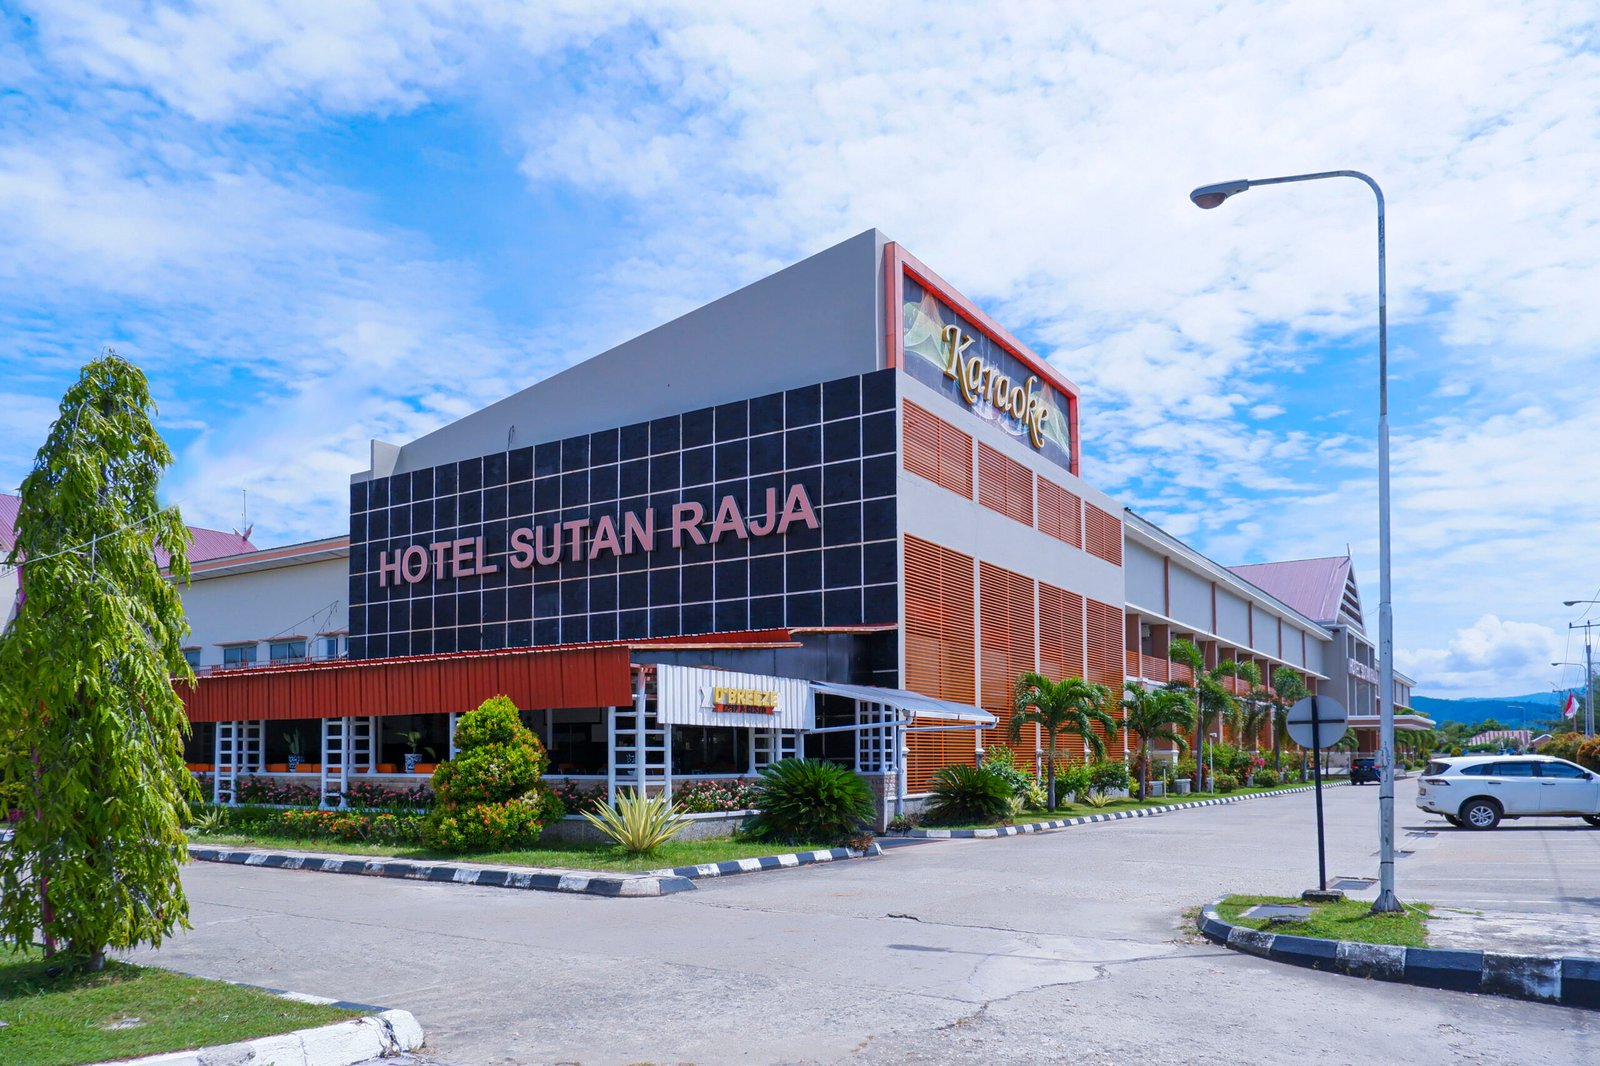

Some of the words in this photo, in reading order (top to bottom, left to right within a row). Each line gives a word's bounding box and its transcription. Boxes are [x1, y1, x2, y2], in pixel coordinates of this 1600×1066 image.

[942, 324, 1048, 448] Karaoke
[379, 535, 499, 588] HOTEL
[509, 507, 656, 569] SUTAN
[671, 483, 820, 548] RAJA
